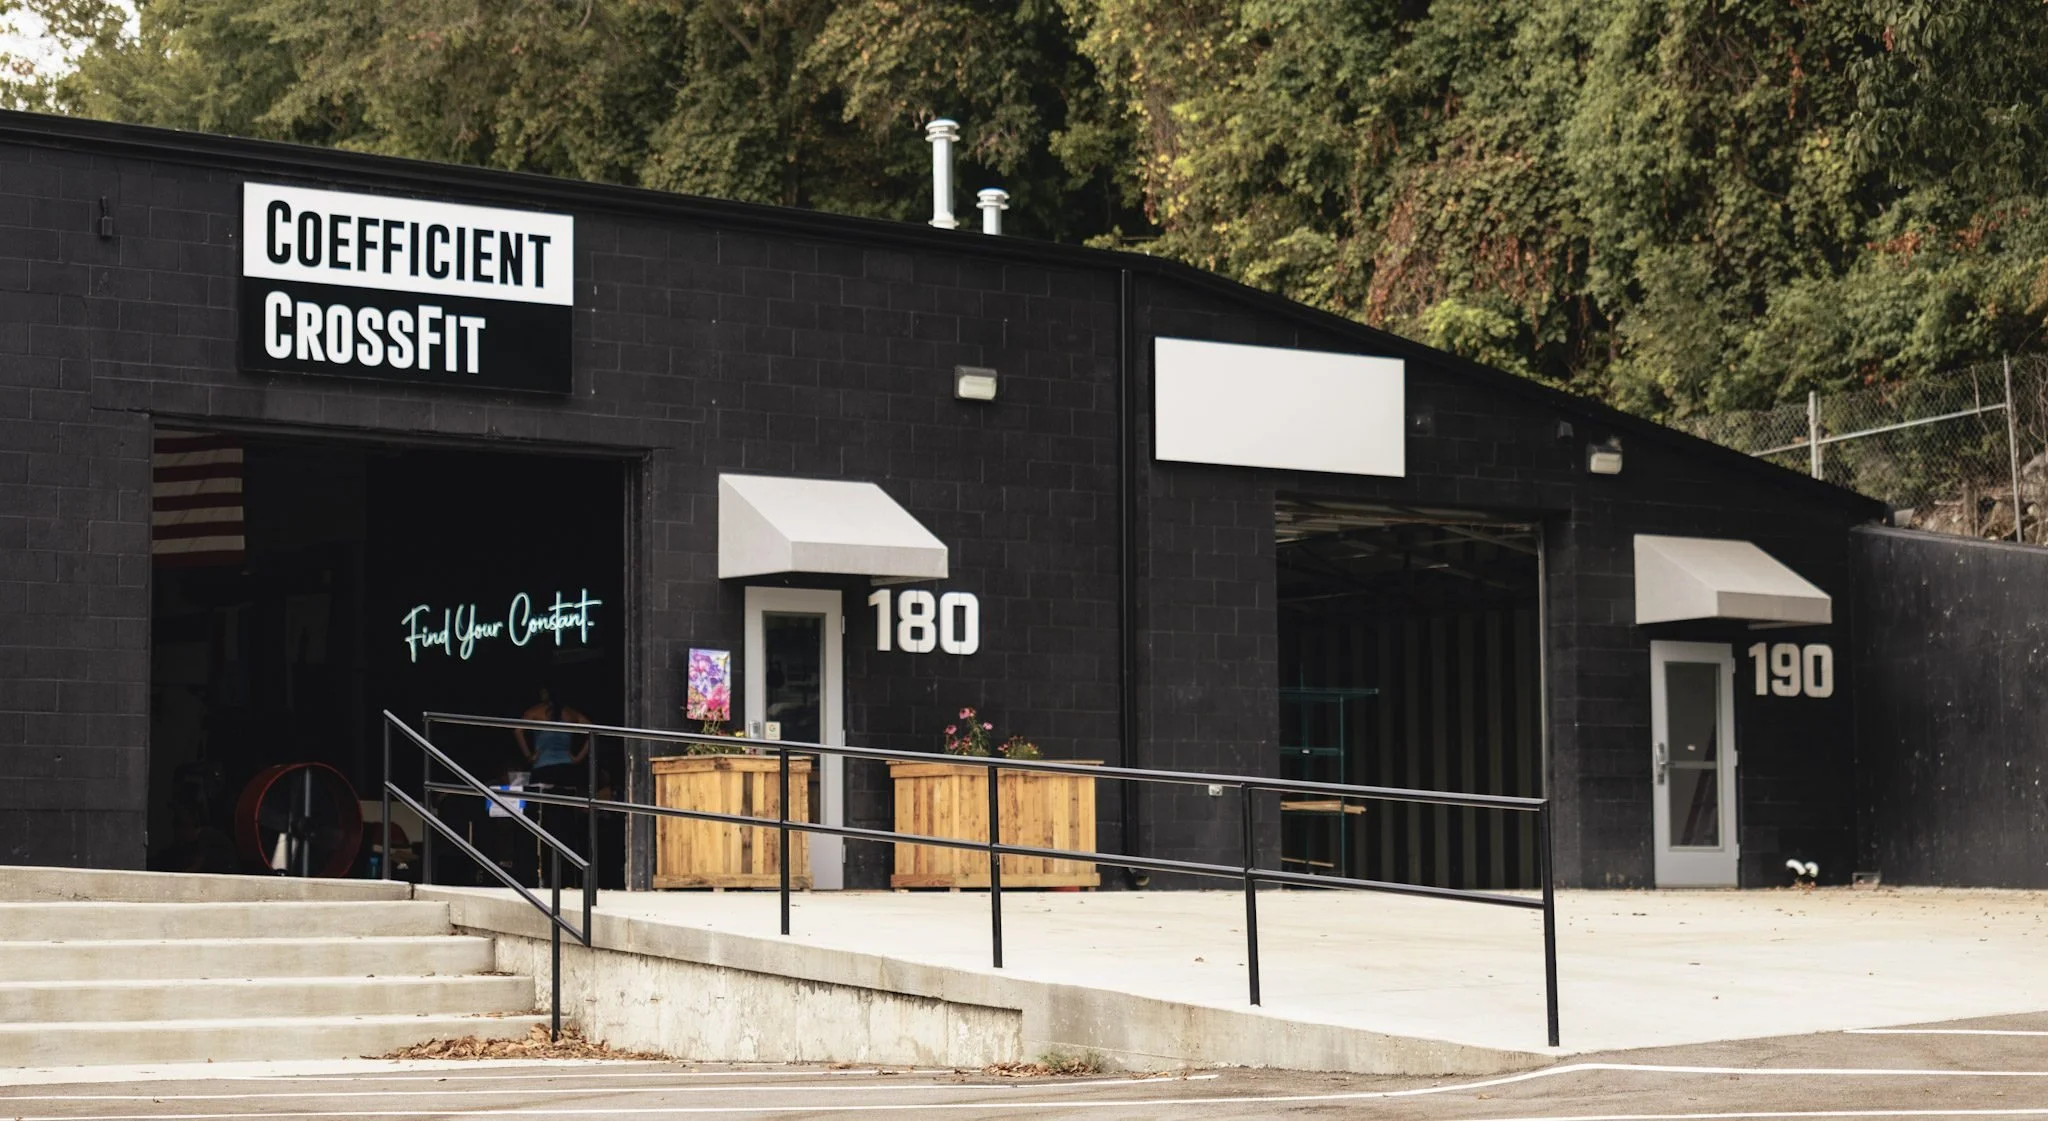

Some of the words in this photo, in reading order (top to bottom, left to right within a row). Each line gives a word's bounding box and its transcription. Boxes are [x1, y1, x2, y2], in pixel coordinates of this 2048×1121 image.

[266, 199, 552, 289] COEFFICIENT
[401, 604, 451, 663] Find
[454, 603, 504, 660] Your
[868, 589, 980, 655] 180
[1749, 642, 1834, 698] 190
